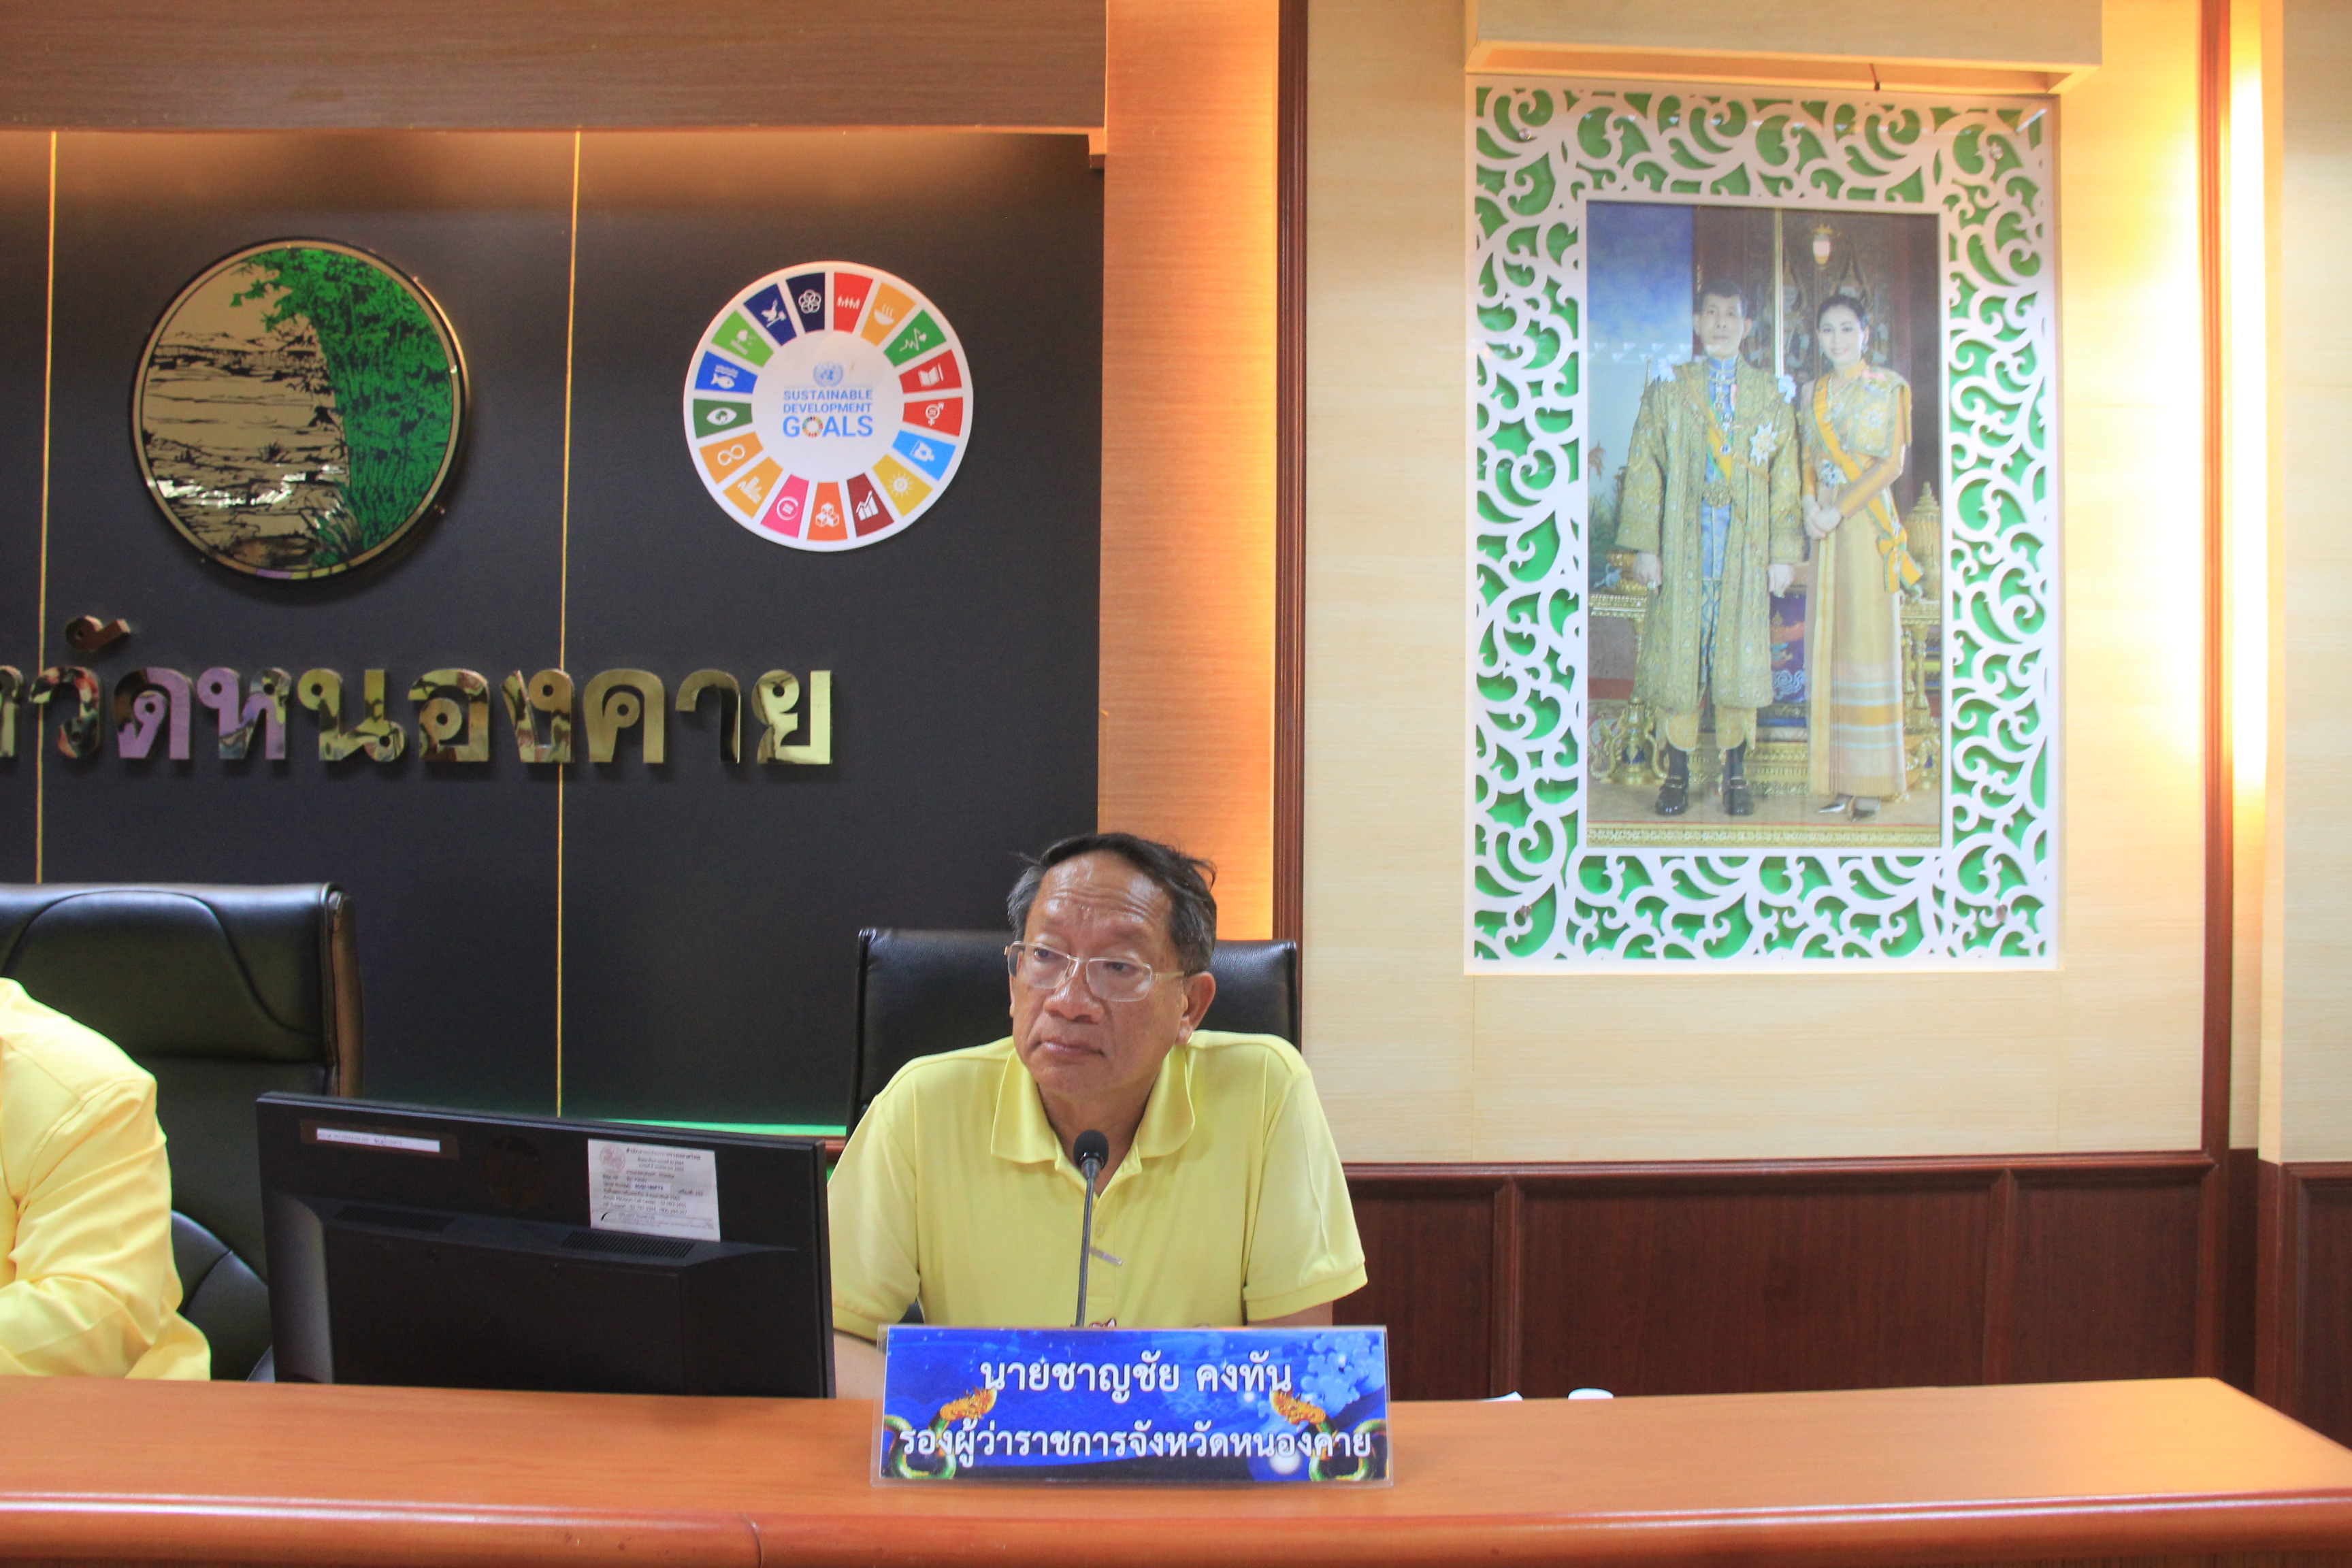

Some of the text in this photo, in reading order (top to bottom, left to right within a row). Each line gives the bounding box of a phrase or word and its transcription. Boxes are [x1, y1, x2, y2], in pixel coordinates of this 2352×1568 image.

[783, 389, 873, 400] SUSTAINABLE
[783, 403, 872, 413] DEVELOPMENT
[783, 415, 873, 438] GOALS
[0, 615, 832, 765] วัดหนองคาย
[979, 1350, 1292, 1404] นายชาญชัย คงทัน
[899, 1416, 1372, 1469] รองผู้ว่าราชการจังหวัดหนองคาย
